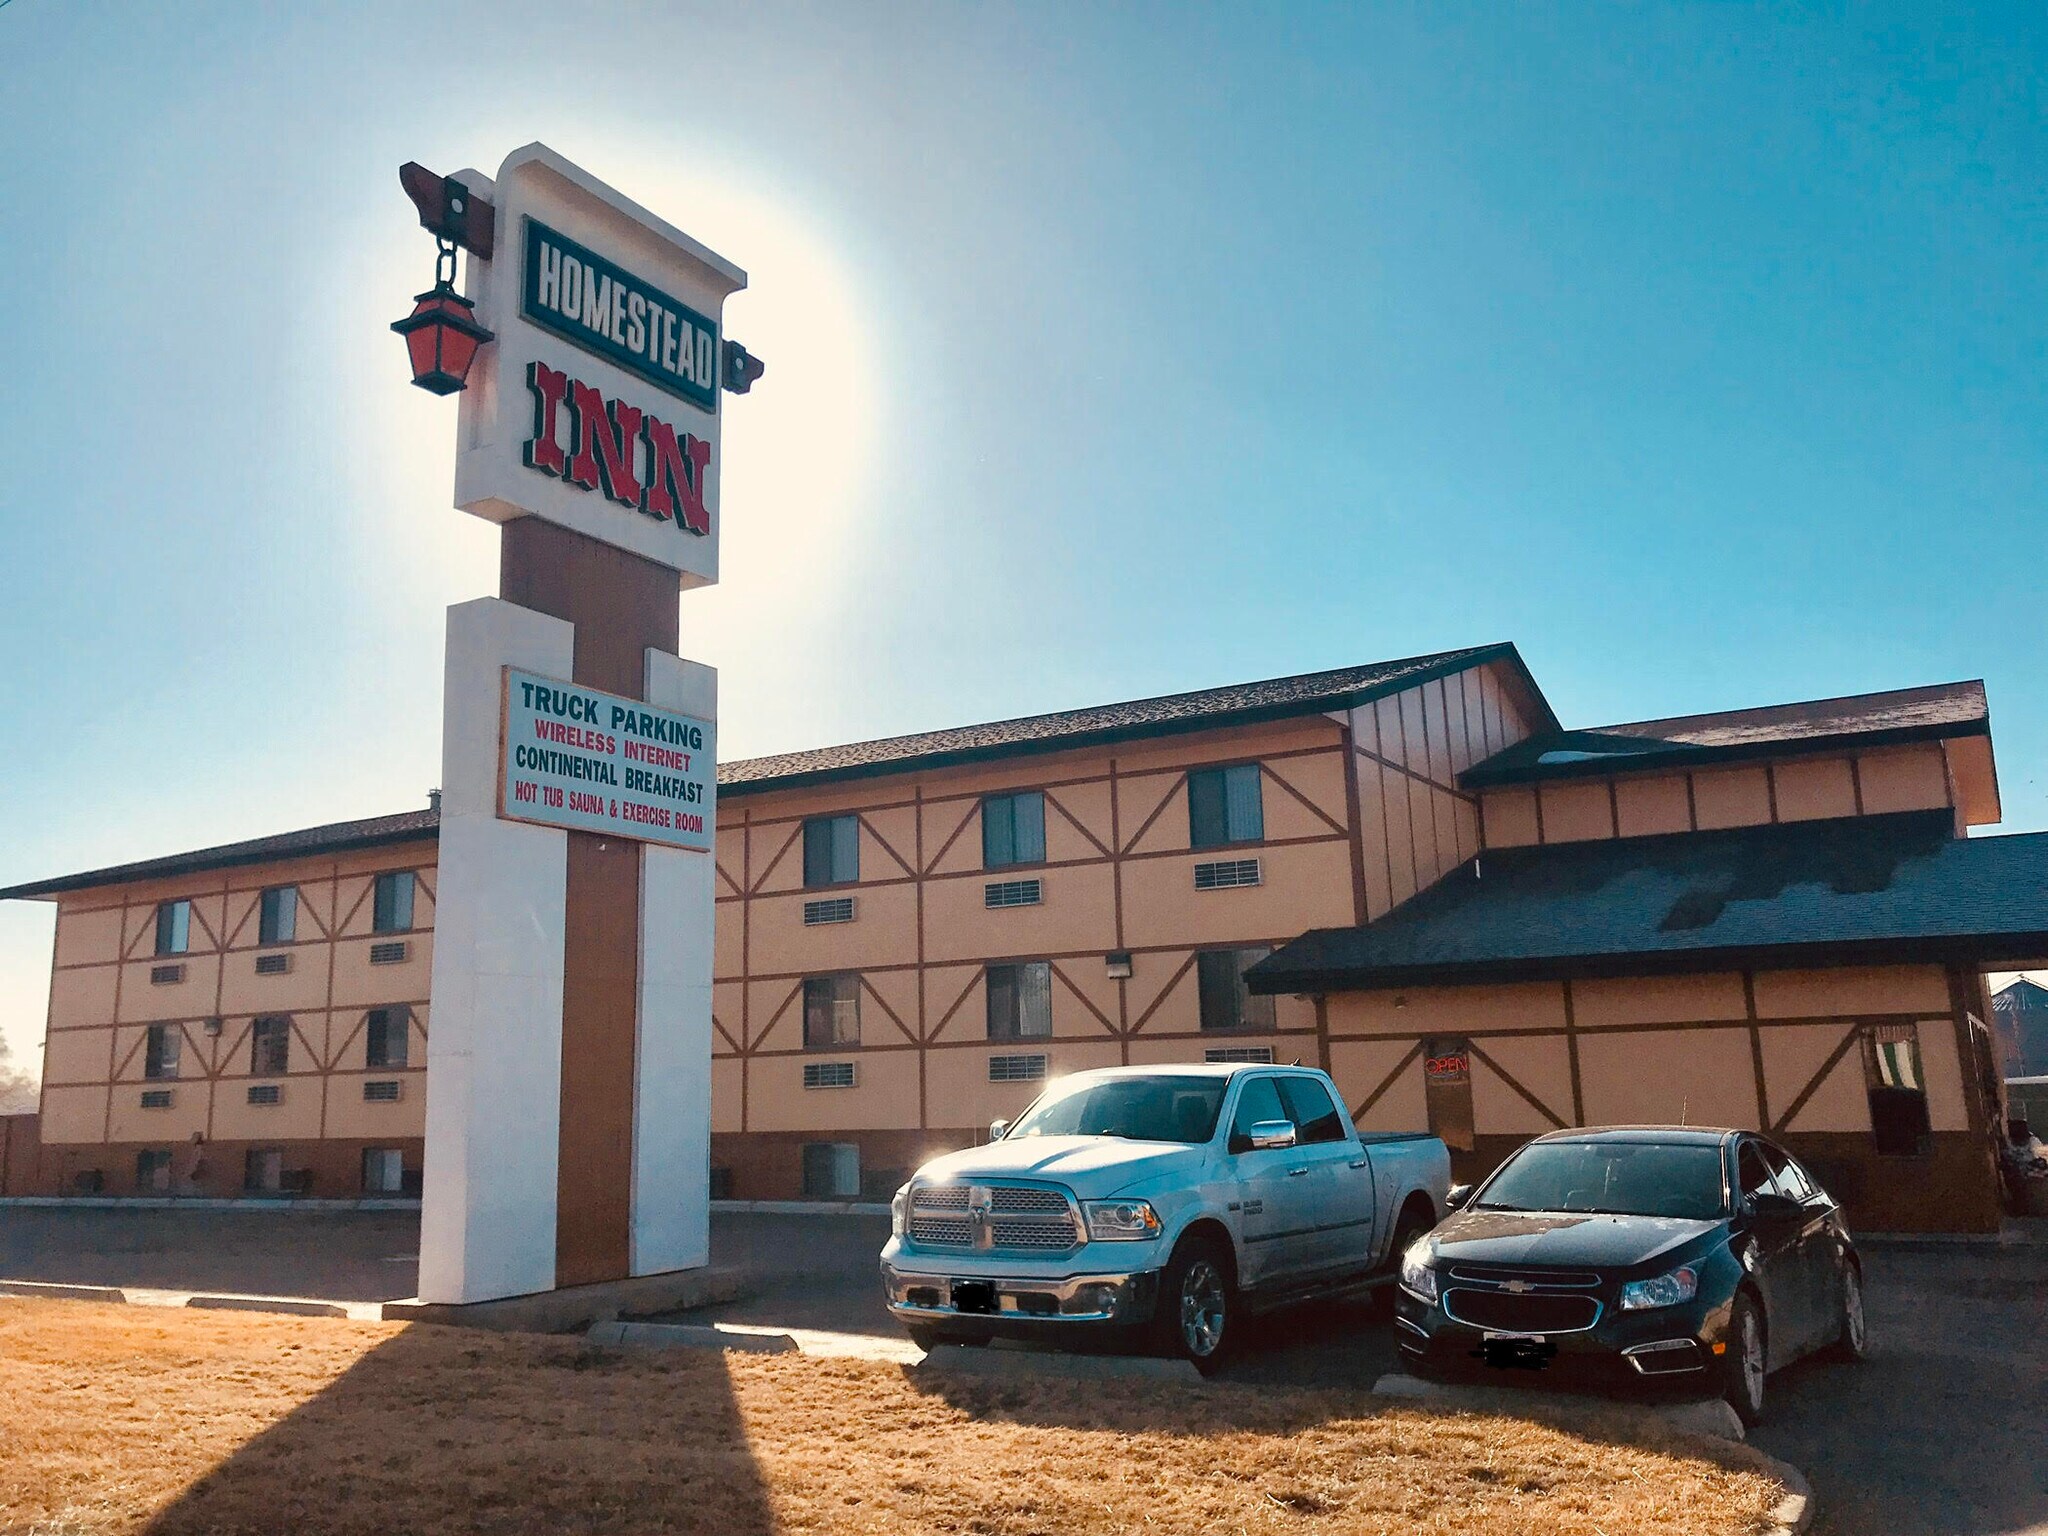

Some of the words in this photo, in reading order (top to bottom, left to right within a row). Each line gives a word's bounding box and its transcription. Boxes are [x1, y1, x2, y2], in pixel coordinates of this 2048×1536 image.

[538, 241, 714, 389] HOMESTEAD
[522, 361, 711, 536] INN
[521, 682, 598, 724] TRUCK
[611, 706, 702, 750] PARKING
[515, 745, 618, 785] CONTINENTAL
[625, 768, 703, 803] BREAKFAST
[535, 719, 616, 754] WIRELESS
[624, 740, 691, 772] INTERNET
[515, 781, 537, 803] HOT
[543, 786, 563, 808] TUB
[569, 792, 604, 815] SAUNA
[609, 800, 617, 818] &
[623, 802, 670, 827] EXERCISE
[675, 812, 703, 833] ROOM
[1425, 1056, 1467, 1074] OPEN
